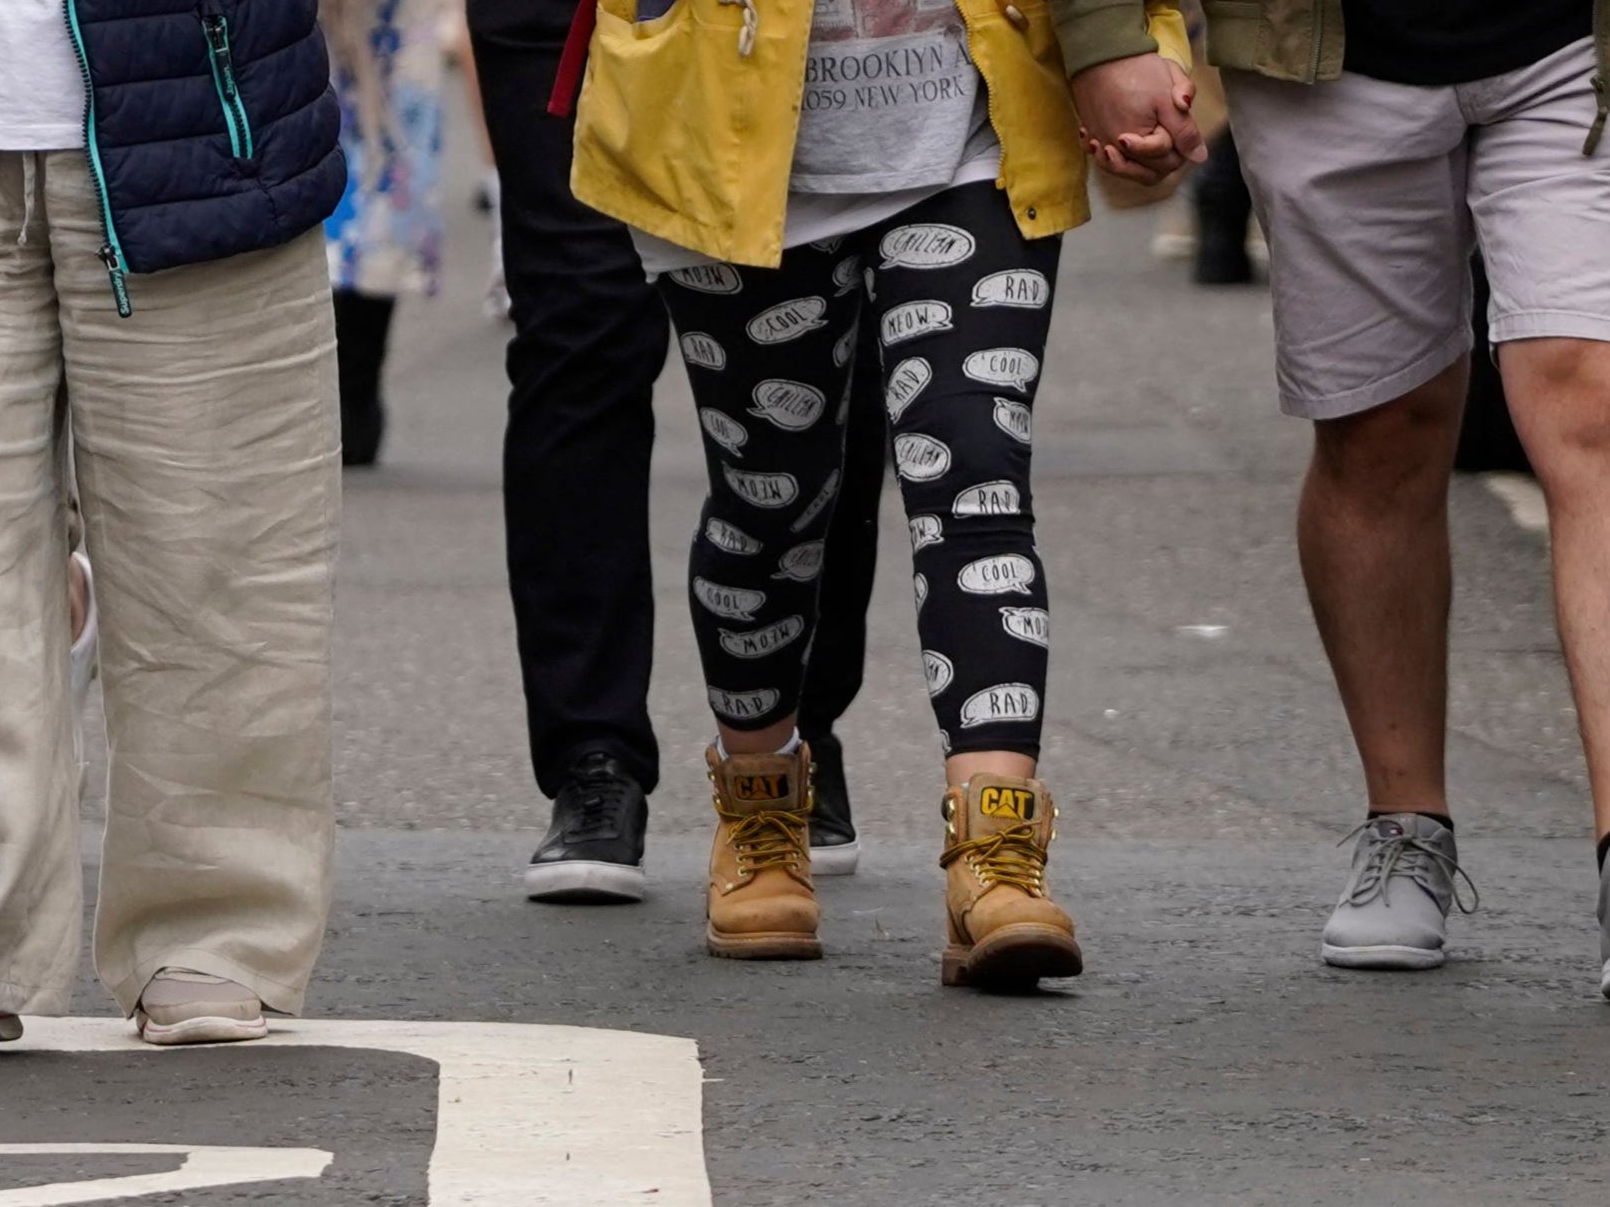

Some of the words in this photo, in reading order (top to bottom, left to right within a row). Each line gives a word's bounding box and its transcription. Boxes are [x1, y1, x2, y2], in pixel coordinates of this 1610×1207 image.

[854, 84, 900, 110] NEW
[908, 74, 965, 103] YORK
[1004, 276, 1039, 301] RAD
[765, 307, 806, 336] COOL
[887, 307, 927, 337] MEOW
[990, 355, 1022, 375] COOL
[890, 369, 920, 401] RAD
[978, 489, 1011, 514] RAD
[981, 561, 1016, 583] COOL
[705, 587, 739, 610] COOL
[721, 694, 762, 715] RAD
[990, 692, 1027, 715] RAD
[736, 775, 779, 801] CAT
[981, 787, 1033, 820] CAT
